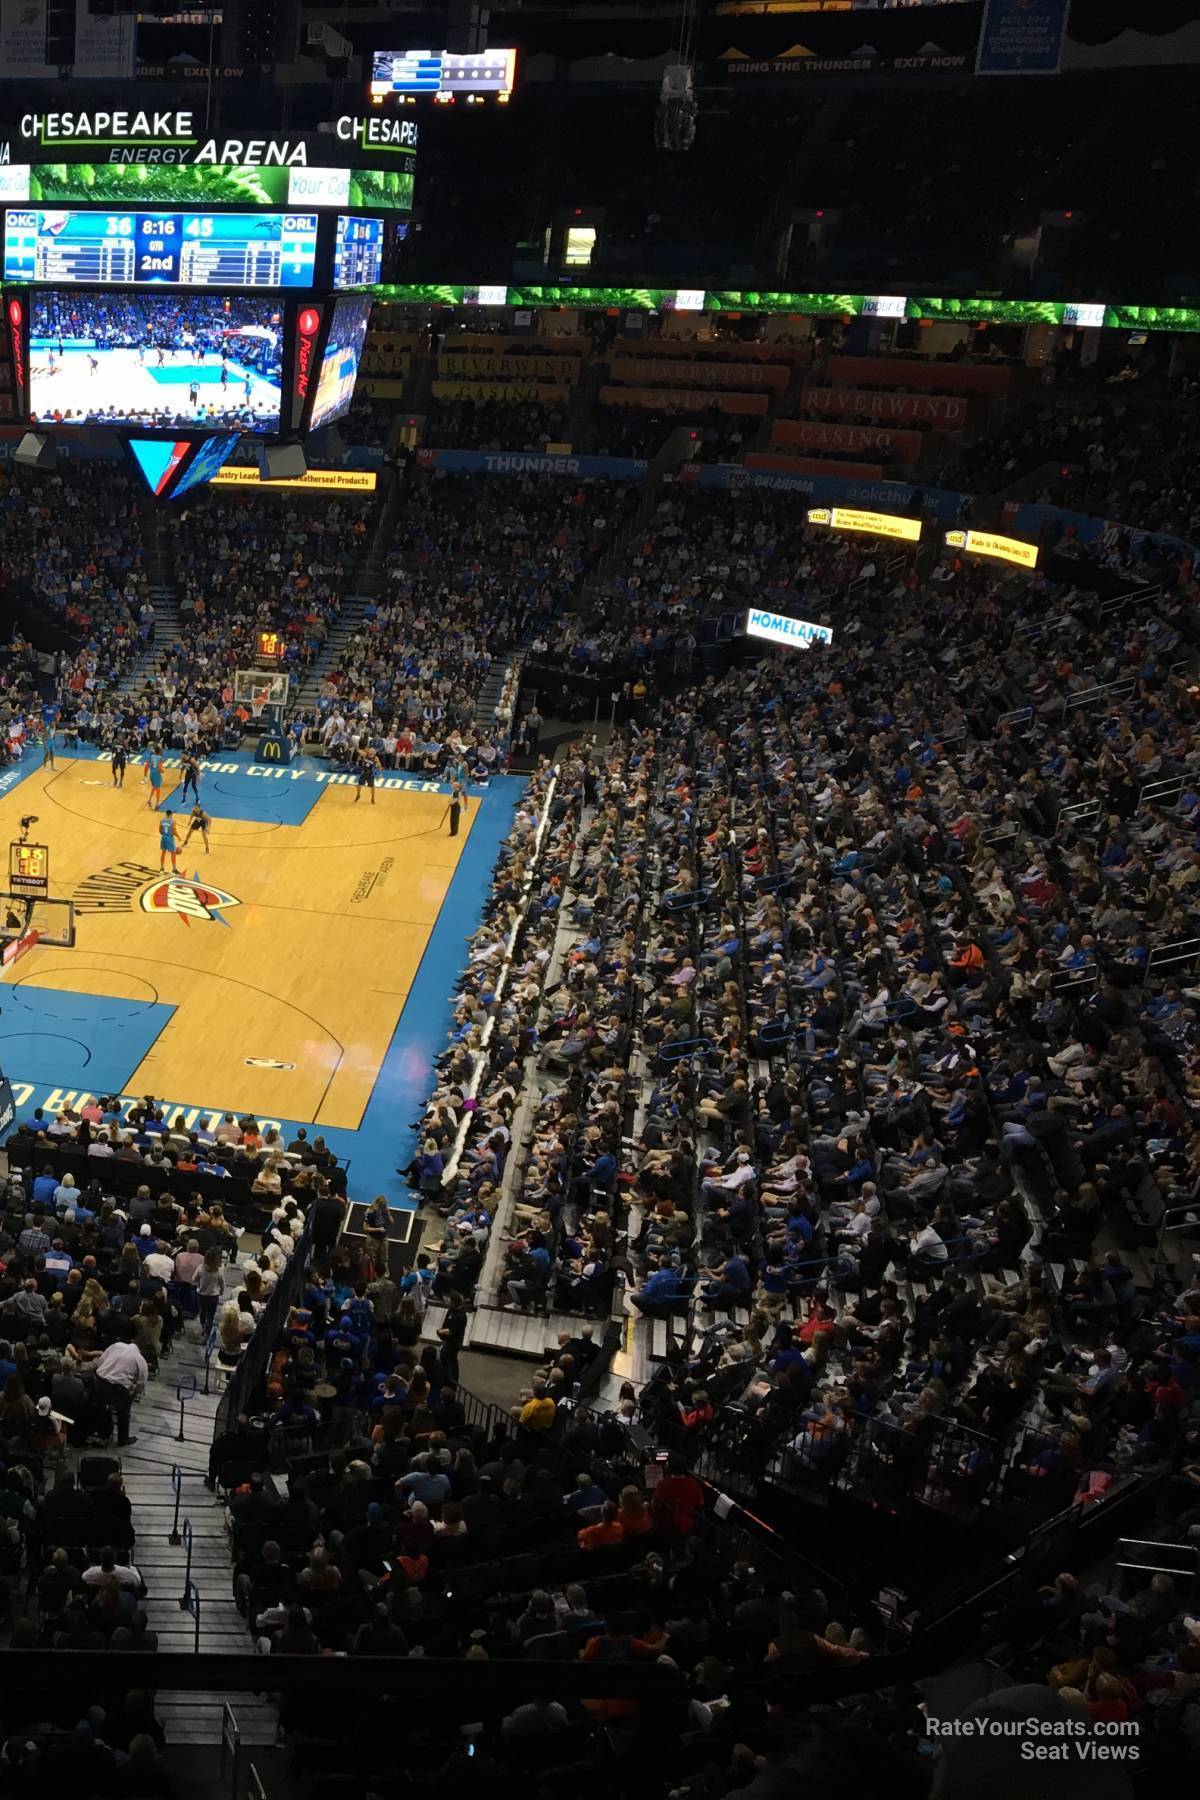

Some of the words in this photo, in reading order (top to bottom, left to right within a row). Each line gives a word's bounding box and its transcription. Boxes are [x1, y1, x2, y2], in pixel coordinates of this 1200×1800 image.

[728, 61, 769, 73] BRING
[773, 60, 800, 72] THE
[804, 59, 872, 72] THUNDER
[894, 57, 927, 69] EXIT
[930, 55, 966, 67] NOW
[21, 111, 193, 137] CHESAPEAKE
[109, 148, 190, 164] ENERGY
[194, 140, 308, 166] ARENA
[7, 215, 36, 226] OKC
[105, 216, 132, 236] 36
[143, 220, 175, 235] 8:16
[185, 218, 214, 237] 45
[284, 218, 315, 231] ORL
[141, 255, 172, 271] 2nd
[447, 357, 573, 374] RIVERWIND
[636, 363, 763, 383] RIVERWIND
[459, 386, 540, 401] CASINO
[806, 392, 960, 420] RIVERWIND
[800, 427, 892, 450] CASINO
[419, 450, 433, 459] 101
[485, 456, 580, 474] THUNDER
[683, 465, 700, 474] 102
[216, 471, 238, 480] dustry
[240, 472, 260, 480] Leade
[337, 476, 369, 485] Products
[755, 475, 815, 494] OKLAHOMA
[246, 766, 306, 780] CITY
